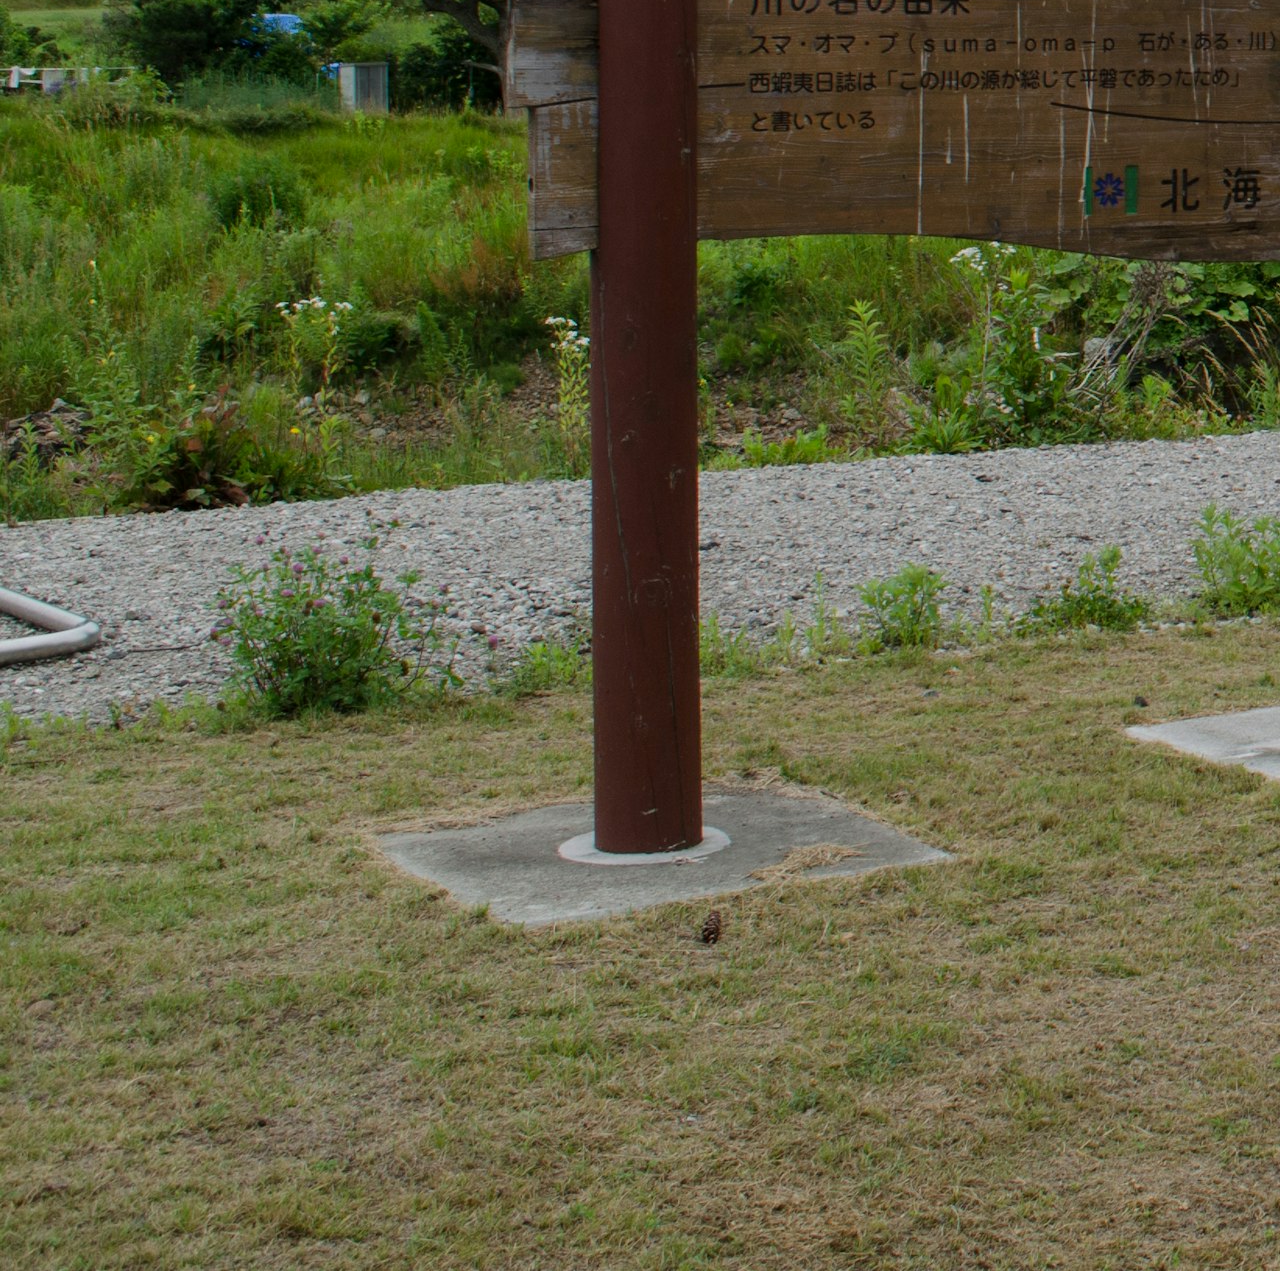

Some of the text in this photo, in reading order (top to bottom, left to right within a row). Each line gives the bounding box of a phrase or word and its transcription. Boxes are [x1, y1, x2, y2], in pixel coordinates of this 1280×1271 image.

[750, 109, 877, 133] と書いている
